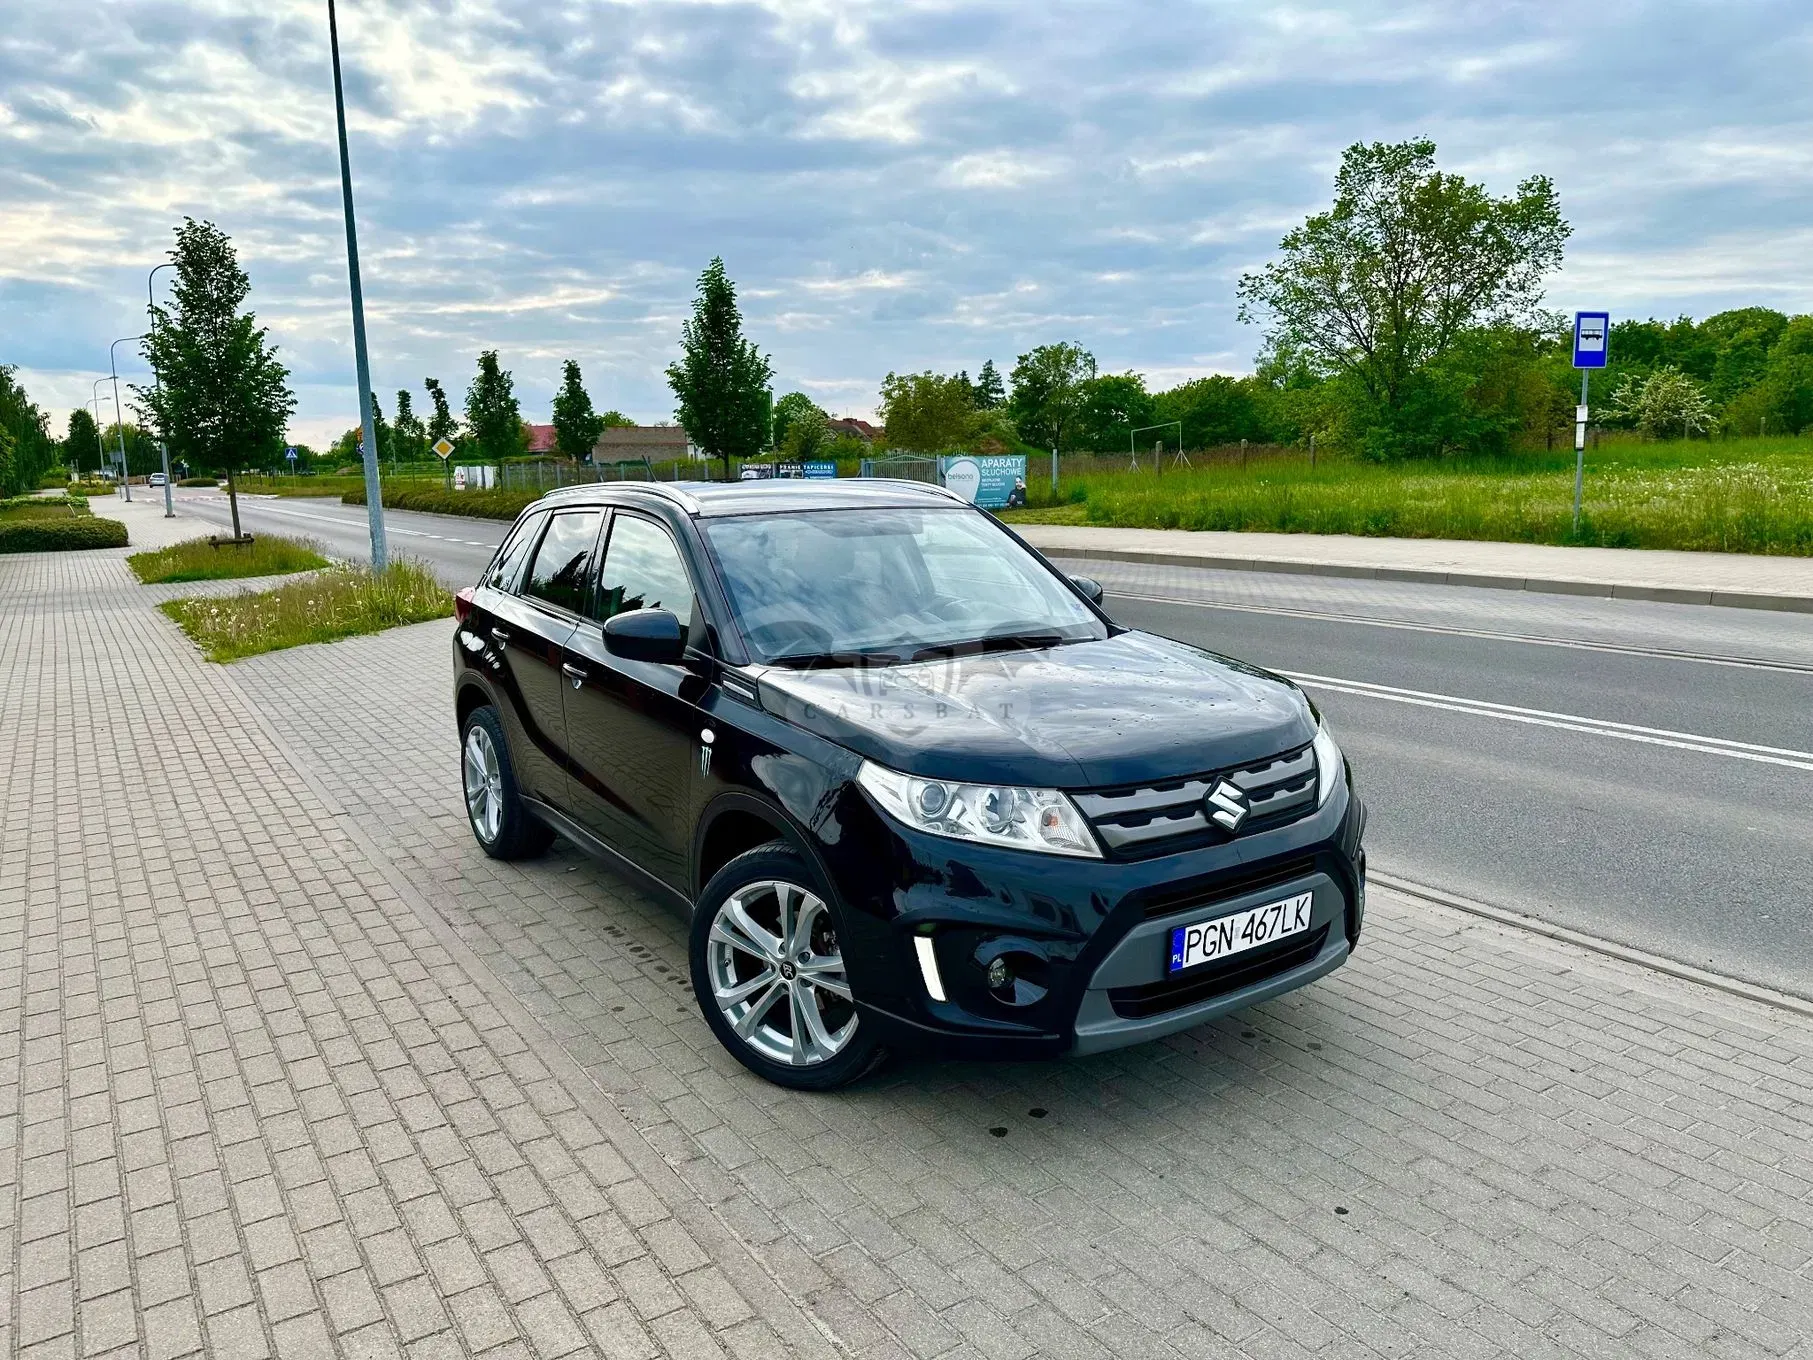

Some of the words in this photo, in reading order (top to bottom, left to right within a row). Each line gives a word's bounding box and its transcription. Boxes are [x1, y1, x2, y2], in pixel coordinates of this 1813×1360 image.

[981, 458, 1023, 468] APARATY
[981, 468, 1022, 477] SŁUCHOWE
[1185, 918, 1235, 963] PGN
[1241, 896, 1309, 945] 467LK
[1172, 954, 1182, 964] PL
